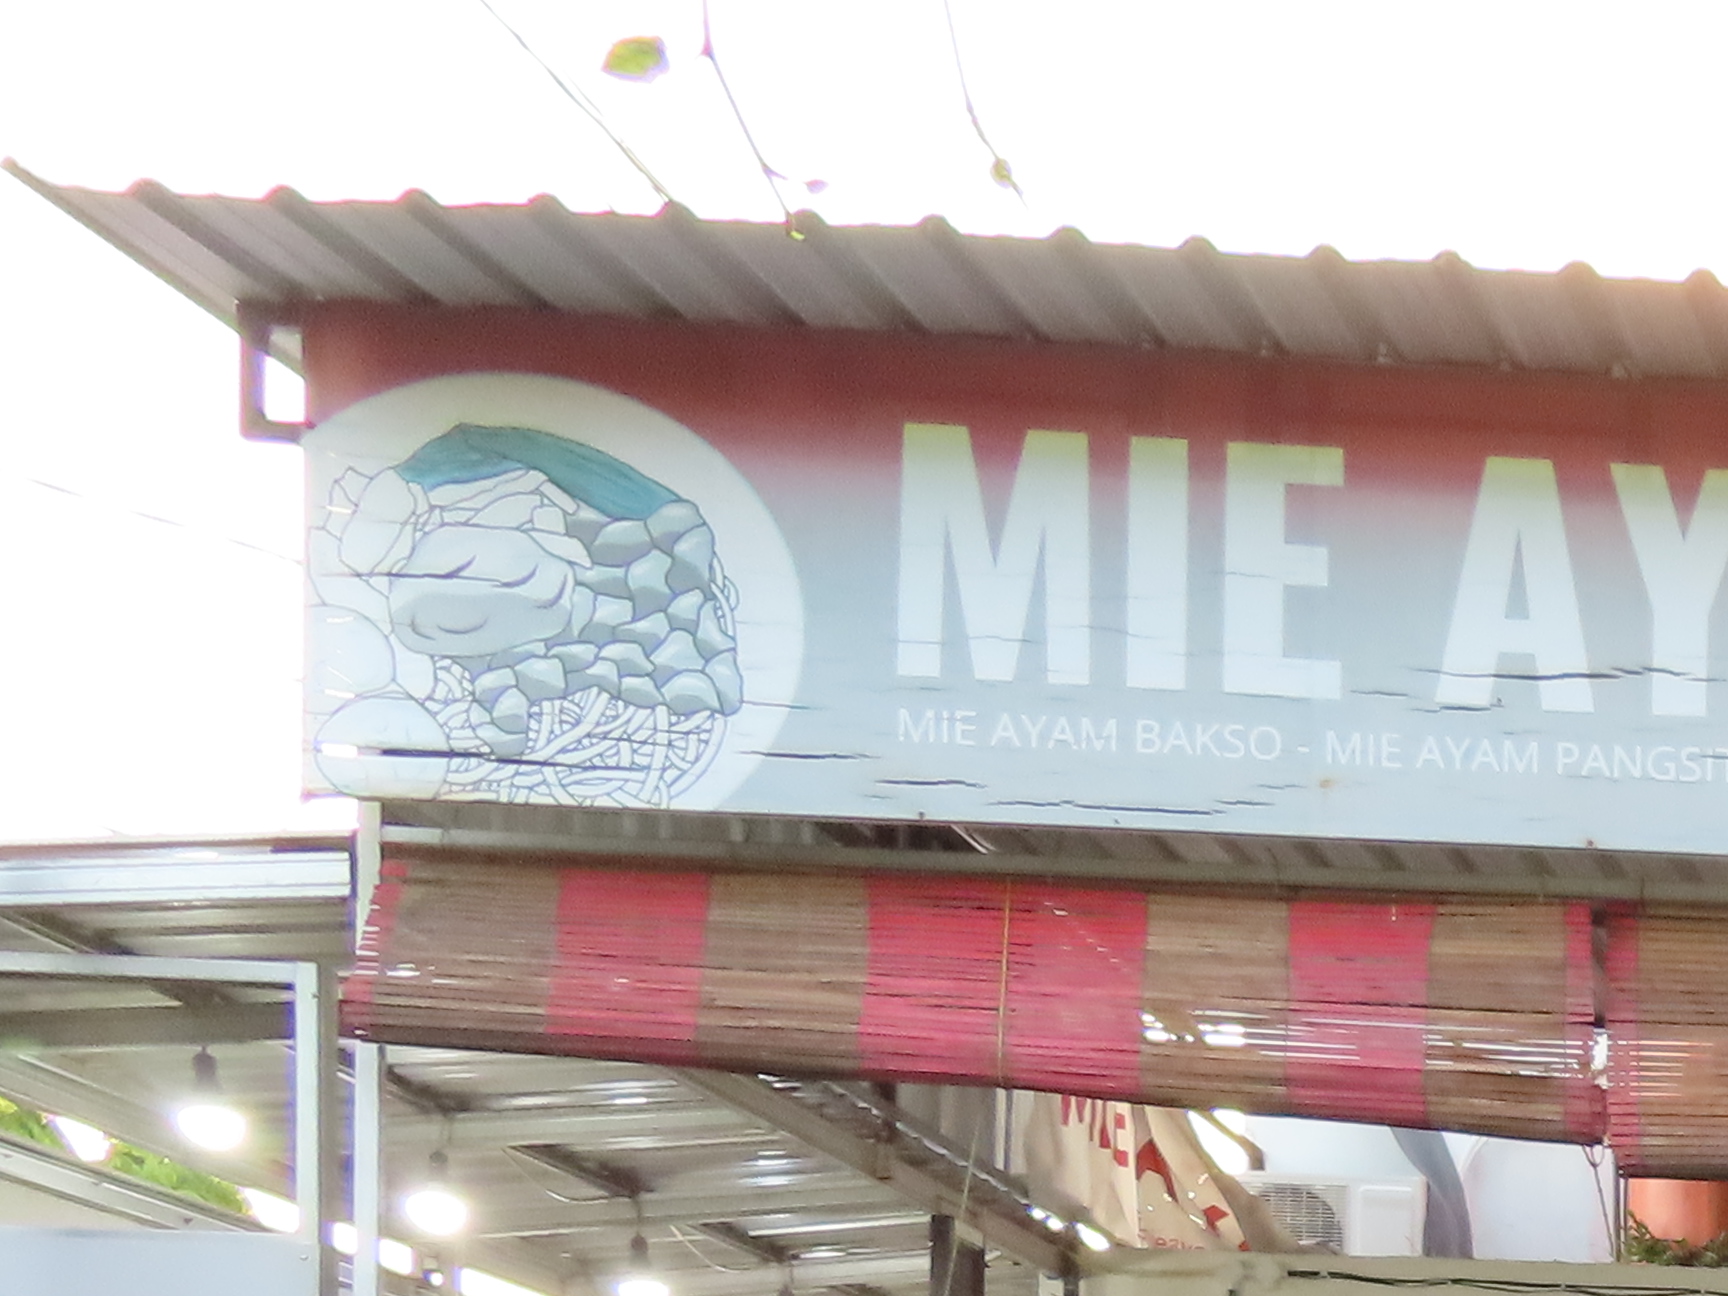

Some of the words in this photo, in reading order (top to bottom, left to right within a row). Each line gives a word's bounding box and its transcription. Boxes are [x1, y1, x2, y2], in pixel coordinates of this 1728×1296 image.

[897, 423, 1345, 701] MIE
[898, 707, 977, 746] MIE
[990, 712, 1118, 752] AYAM
[1134, 719, 1283, 760] BAKSO
[1325, 729, 1403, 768] MIE
[1416, 734, 1539, 775] AYAM
